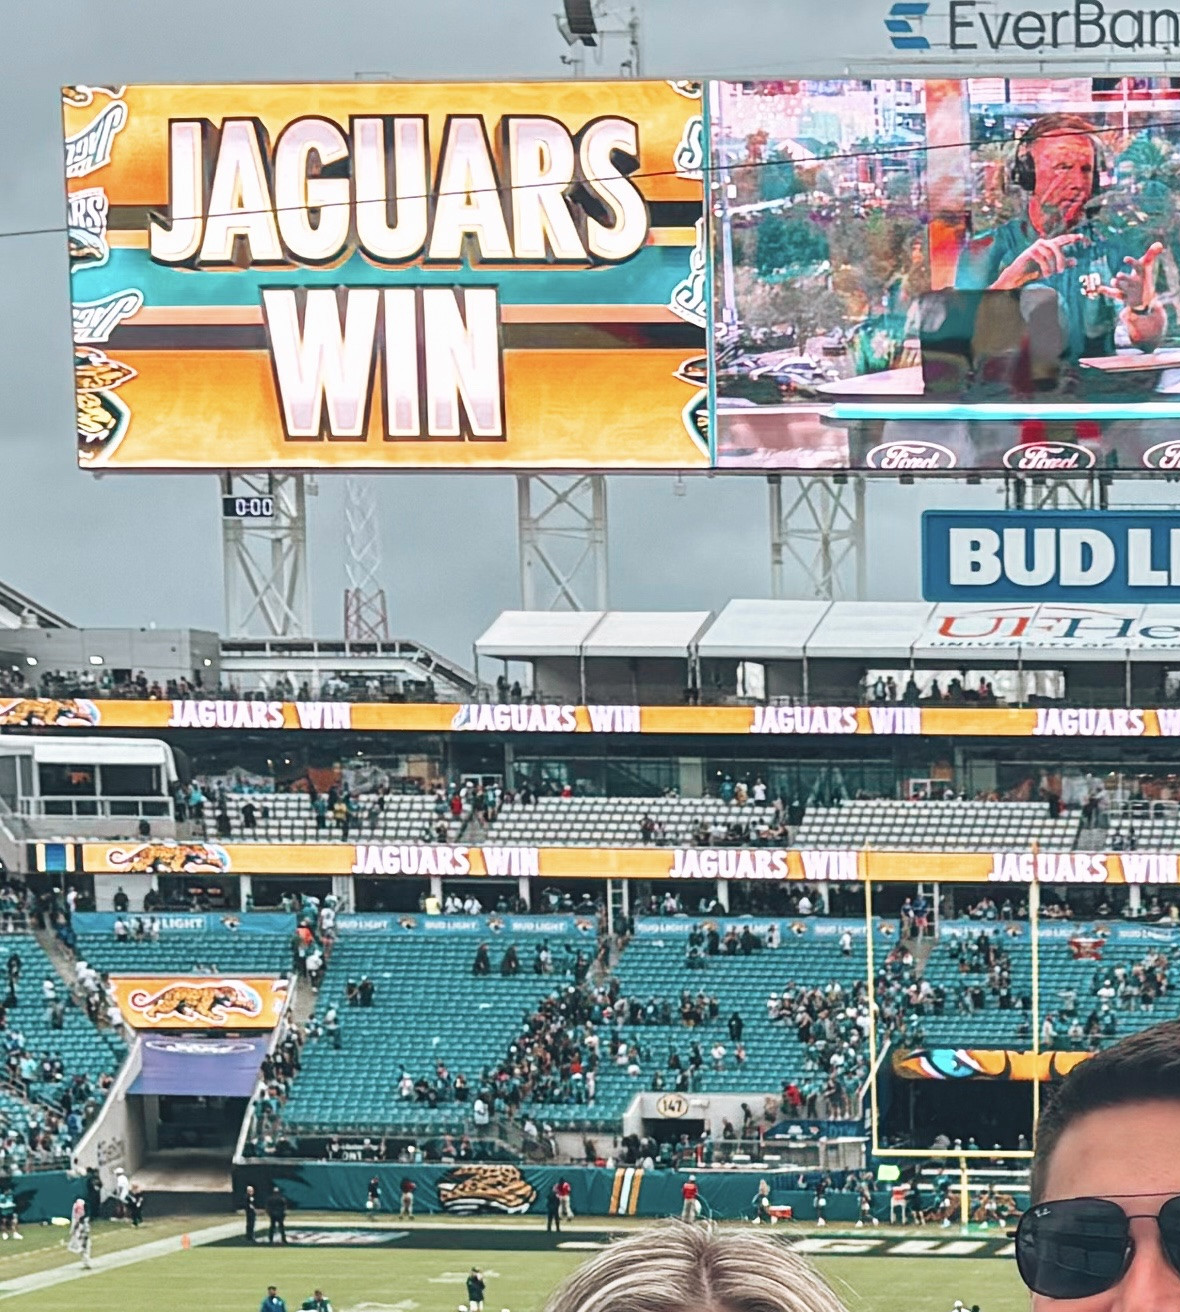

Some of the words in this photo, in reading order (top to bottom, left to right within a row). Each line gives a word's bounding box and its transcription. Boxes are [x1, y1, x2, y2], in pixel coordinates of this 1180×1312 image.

[149, 115, 649, 266] JAGUARS
[260, 285, 506, 441] WIN
[881, 446, 940, 469] Ford
[1018, 446, 1078, 469] Ford
[235, 498, 273, 516] 0:00
[949, 528, 1116, 588] BUD
[168, 700, 284, 729] JAGUARS
[296, 702, 351, 730] WIN
[464, 704, 576, 732] JAGUARS
[586, 705, 641, 733] WIN
[750, 705, 858, 734] JAGUARS
[868, 707, 921, 735] WIN
[1032, 708, 1145, 736] JAGUARS
[351, 845, 470, 876] JAGUARS
[482, 847, 539, 877] WIN
[669, 849, 788, 879] JAGUARS
[800, 851, 859, 880] WIN
[989, 853, 1108, 883] JAGUARS
[1121, 854, 1179, 884] WIN
[162, 917, 203, 929] LIGHT
[663, 1101, 682, 1113] 147
